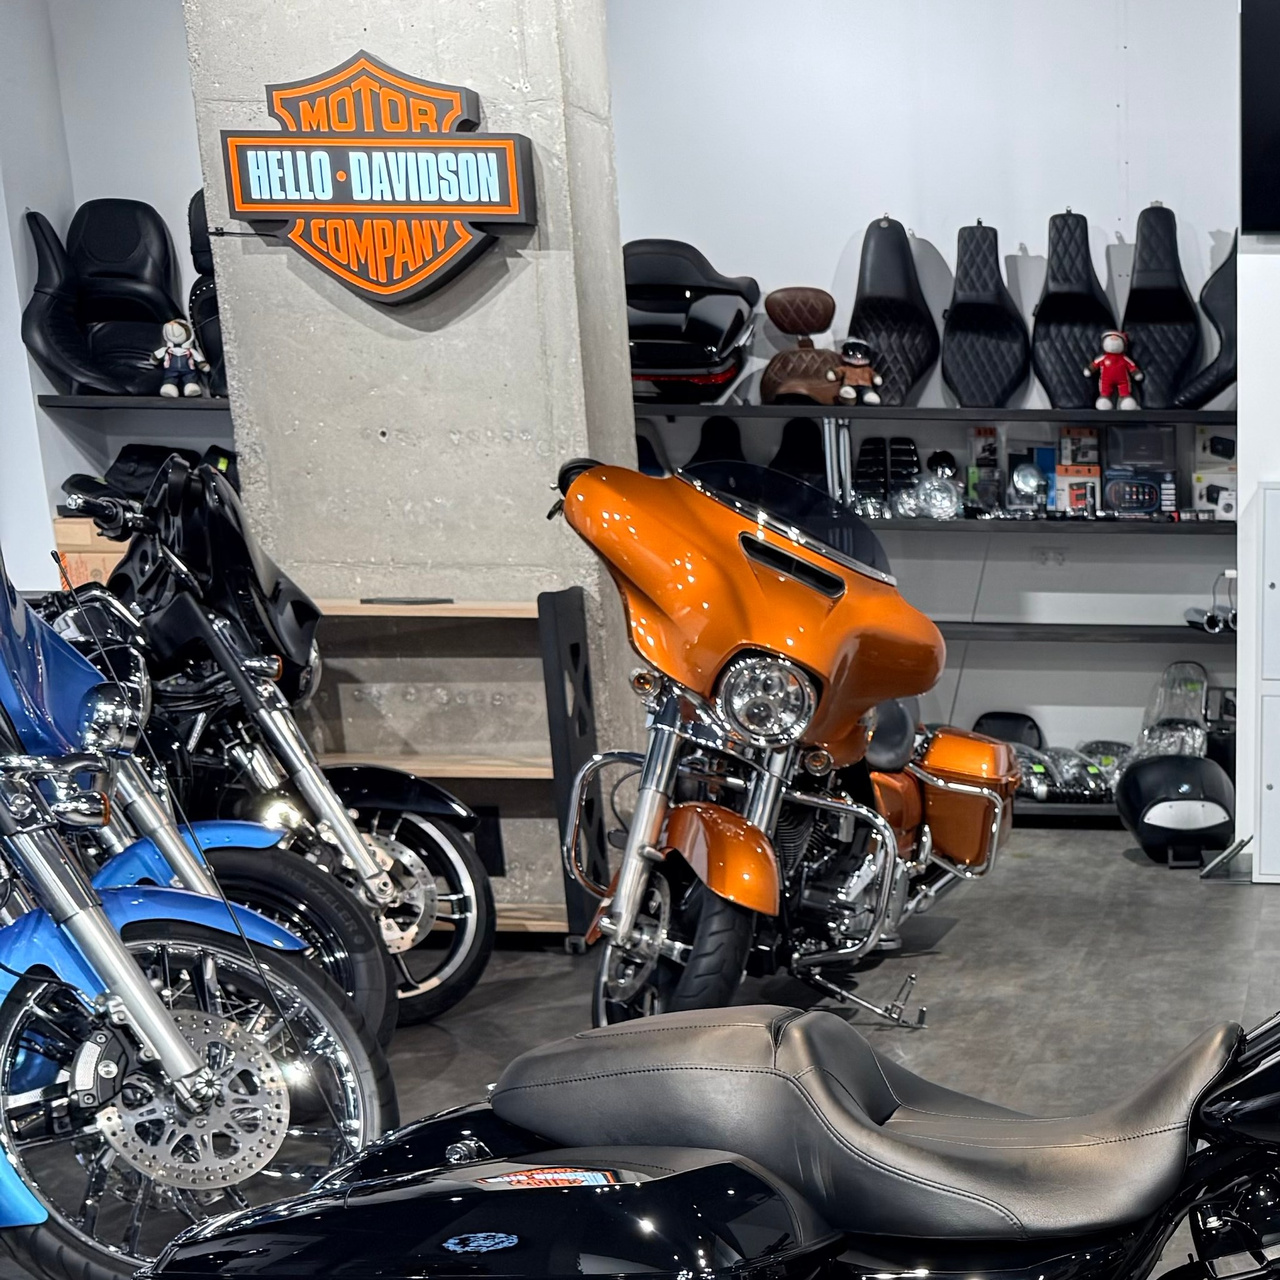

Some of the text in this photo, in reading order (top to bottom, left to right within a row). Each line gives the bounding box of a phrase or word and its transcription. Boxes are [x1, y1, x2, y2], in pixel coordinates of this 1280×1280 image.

[300, 76, 437, 133] MOTOR
[247, 151, 500, 202] HELLO DAVIDSON
[310, 219, 448, 283] COMPANY
